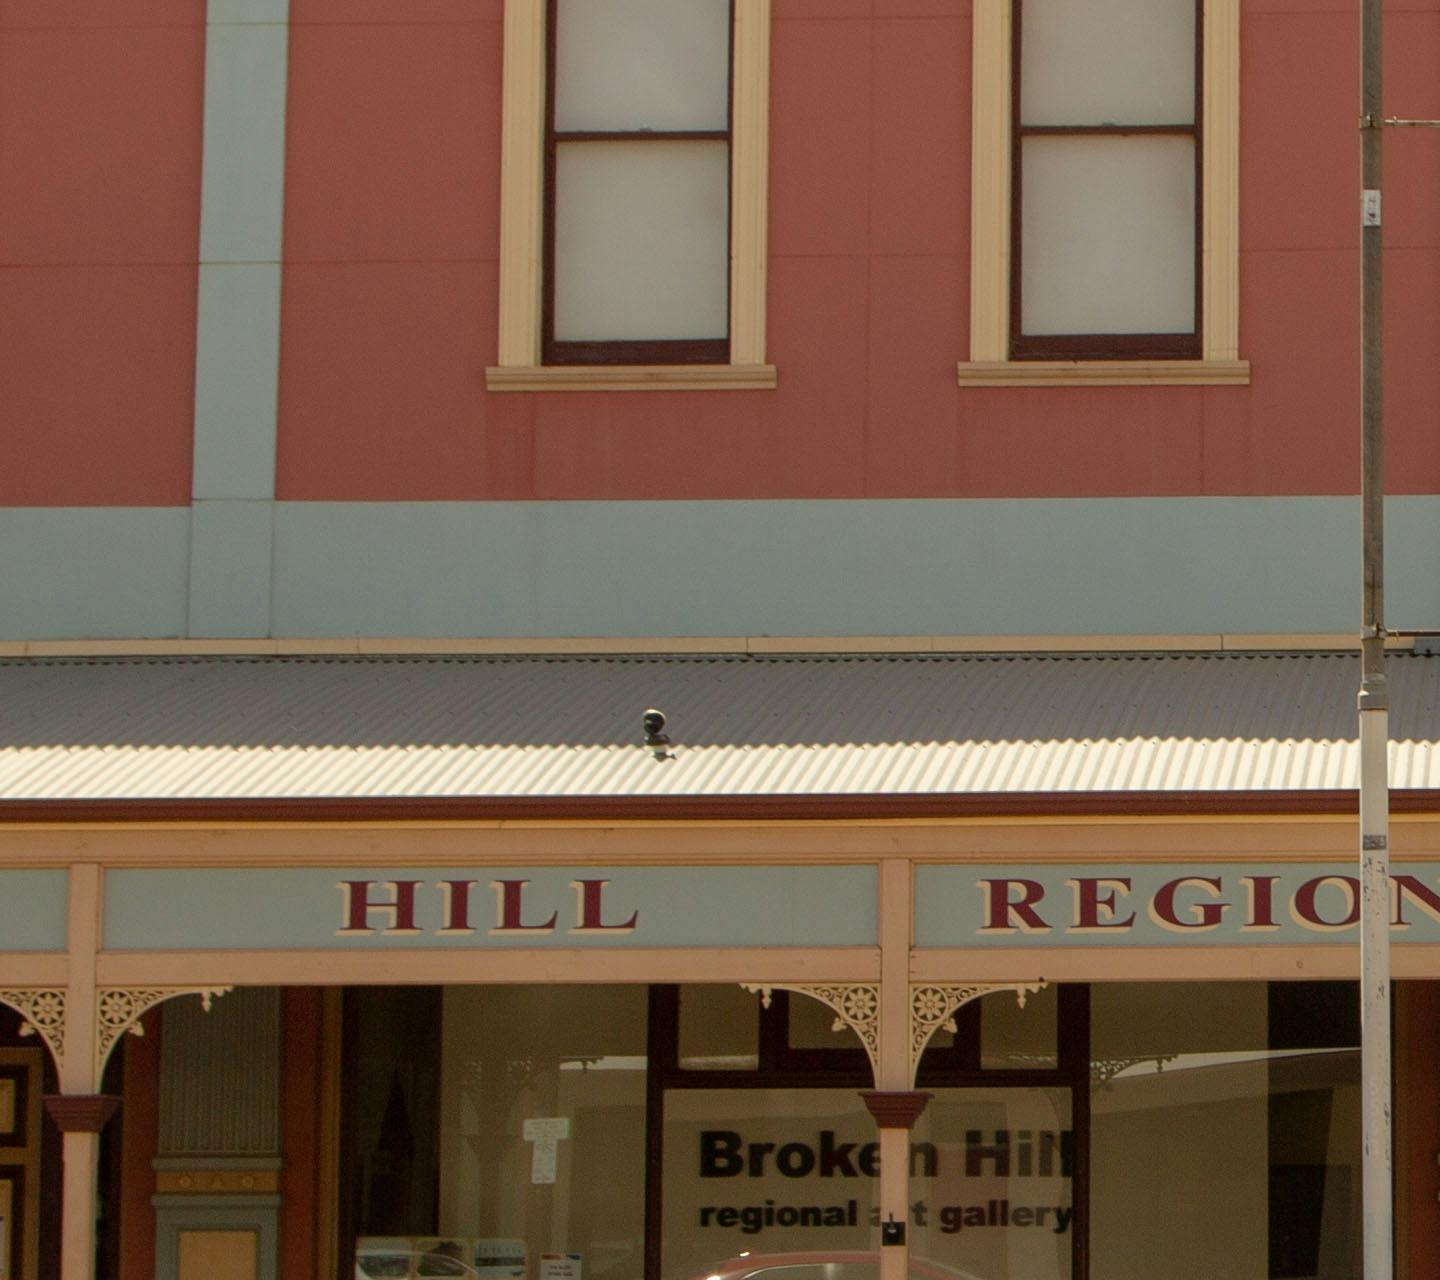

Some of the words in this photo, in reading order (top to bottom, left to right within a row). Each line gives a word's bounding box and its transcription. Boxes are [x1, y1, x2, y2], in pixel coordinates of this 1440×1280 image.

[335, 878, 640, 936] HILL
[965, 1130, 1074, 1178] Hill
[700, 1199, 857, 1234] regional
[940, 1199, 1074, 1234] gallery
